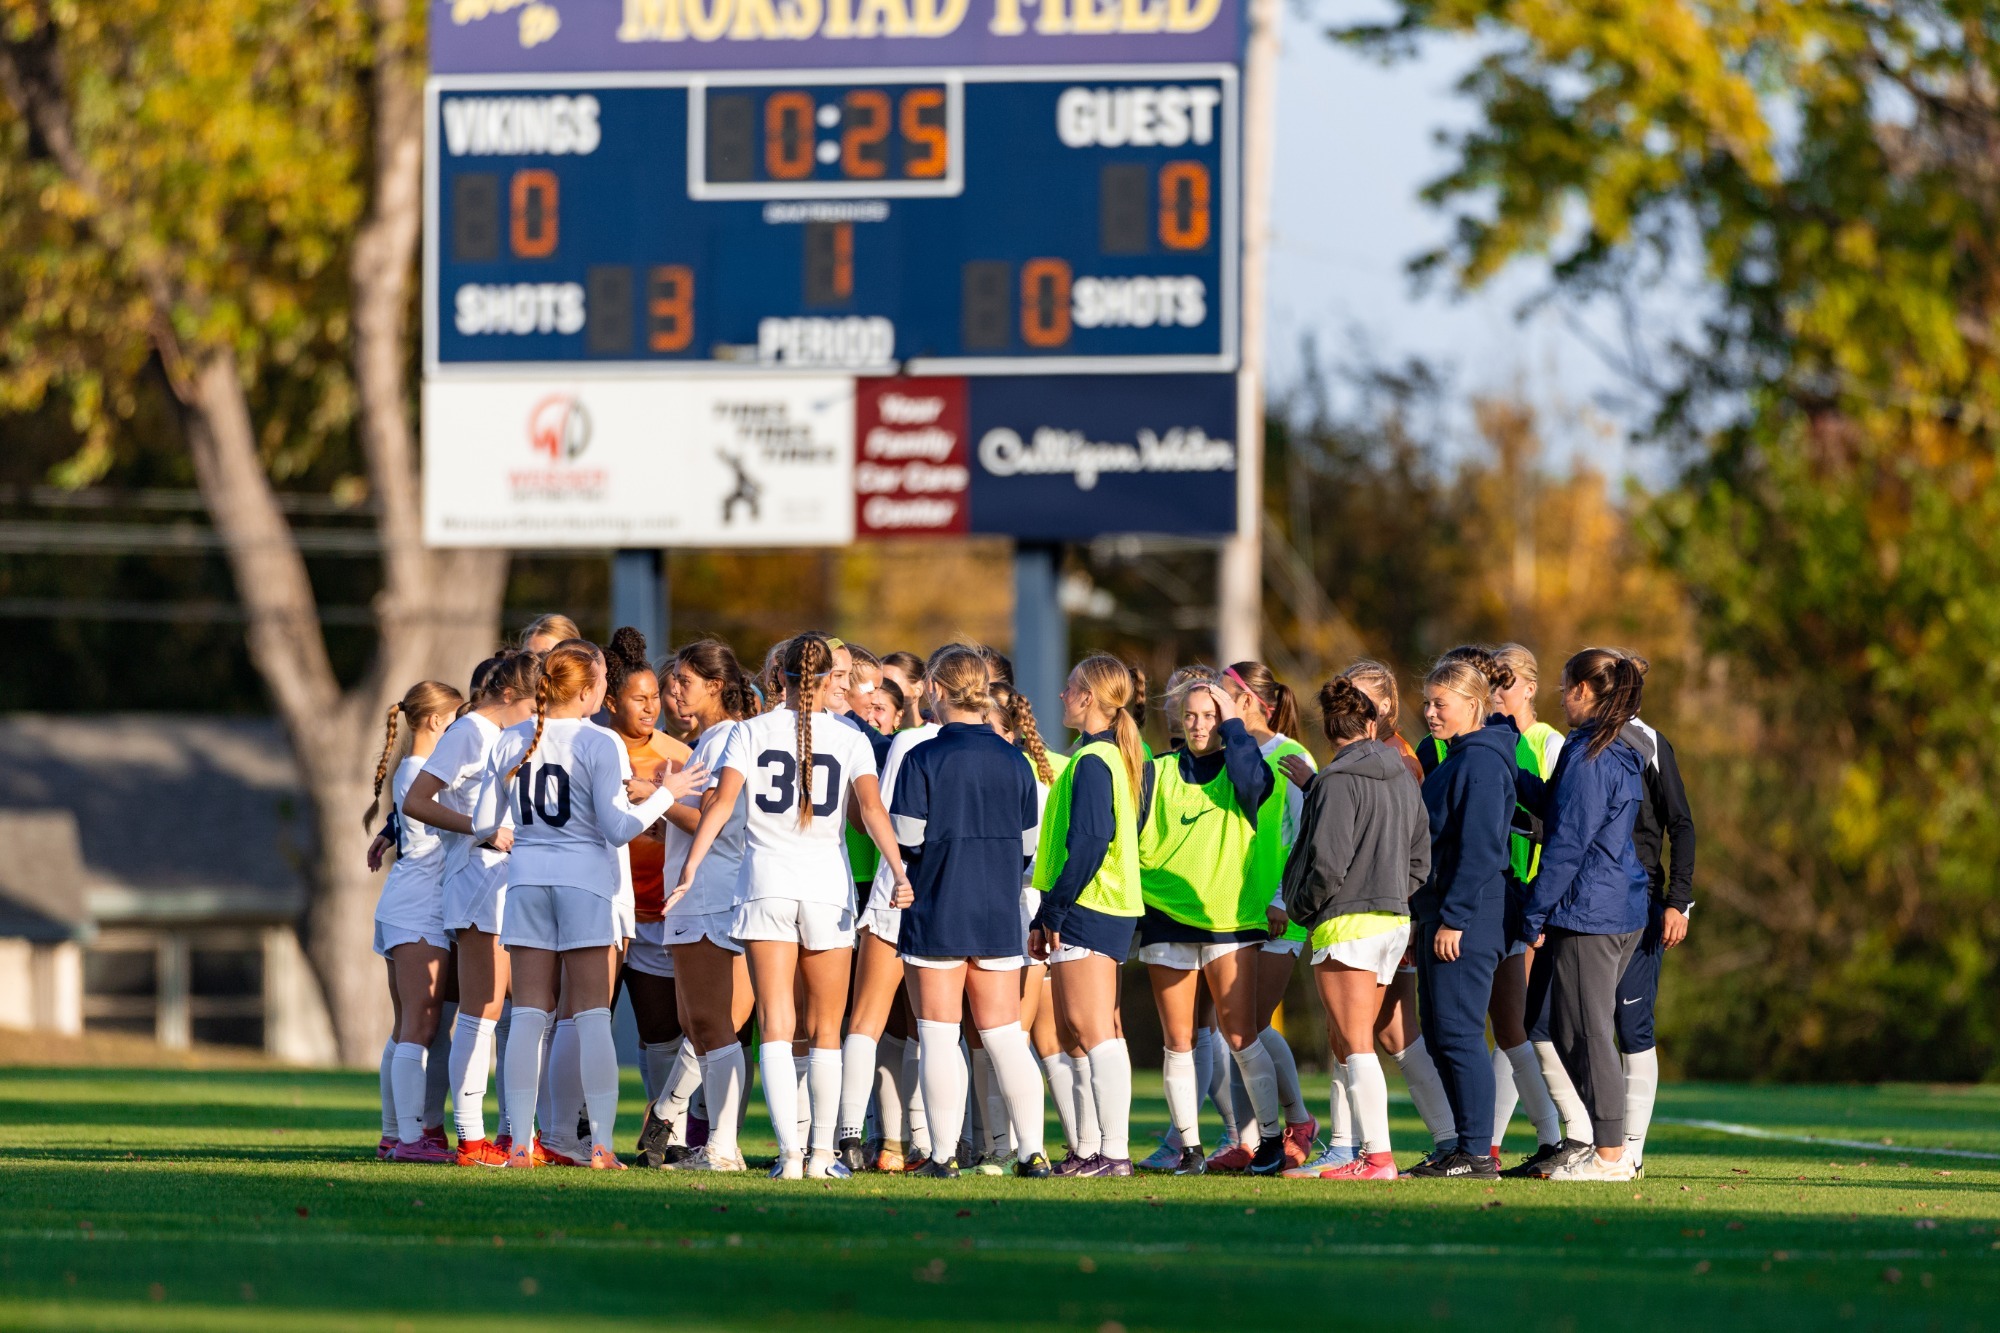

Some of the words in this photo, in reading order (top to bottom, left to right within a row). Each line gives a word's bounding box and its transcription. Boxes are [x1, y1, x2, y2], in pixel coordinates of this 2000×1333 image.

[443, 95, 600, 155] VIKINGS
[765, 89, 948, 180] 0:25
[1057, 86, 1220, 147] GUEST
[511, 169, 558, 258] 0
[1159, 161, 1210, 250] 0
[834, 222, 853, 296] 1
[454, 281, 586, 335] SHOTS
[648, 265, 694, 353] 3
[1020, 257, 1072, 347] 0
[1072, 275, 1206, 328] SHOTS
[758, 316, 895, 367] PERIOD
[877, 393, 946, 424] Your
[864, 427, 957, 462] Family
[978, 426, 1142, 491] Culligan
[856, 460, 902, 494] Car
[902, 460, 969, 493] Care
[863, 495, 958, 528] Center
[515, 762, 571, 827] 10
[755, 749, 841, 817] 30
[1446, 1164, 1472, 1176] HOKA
